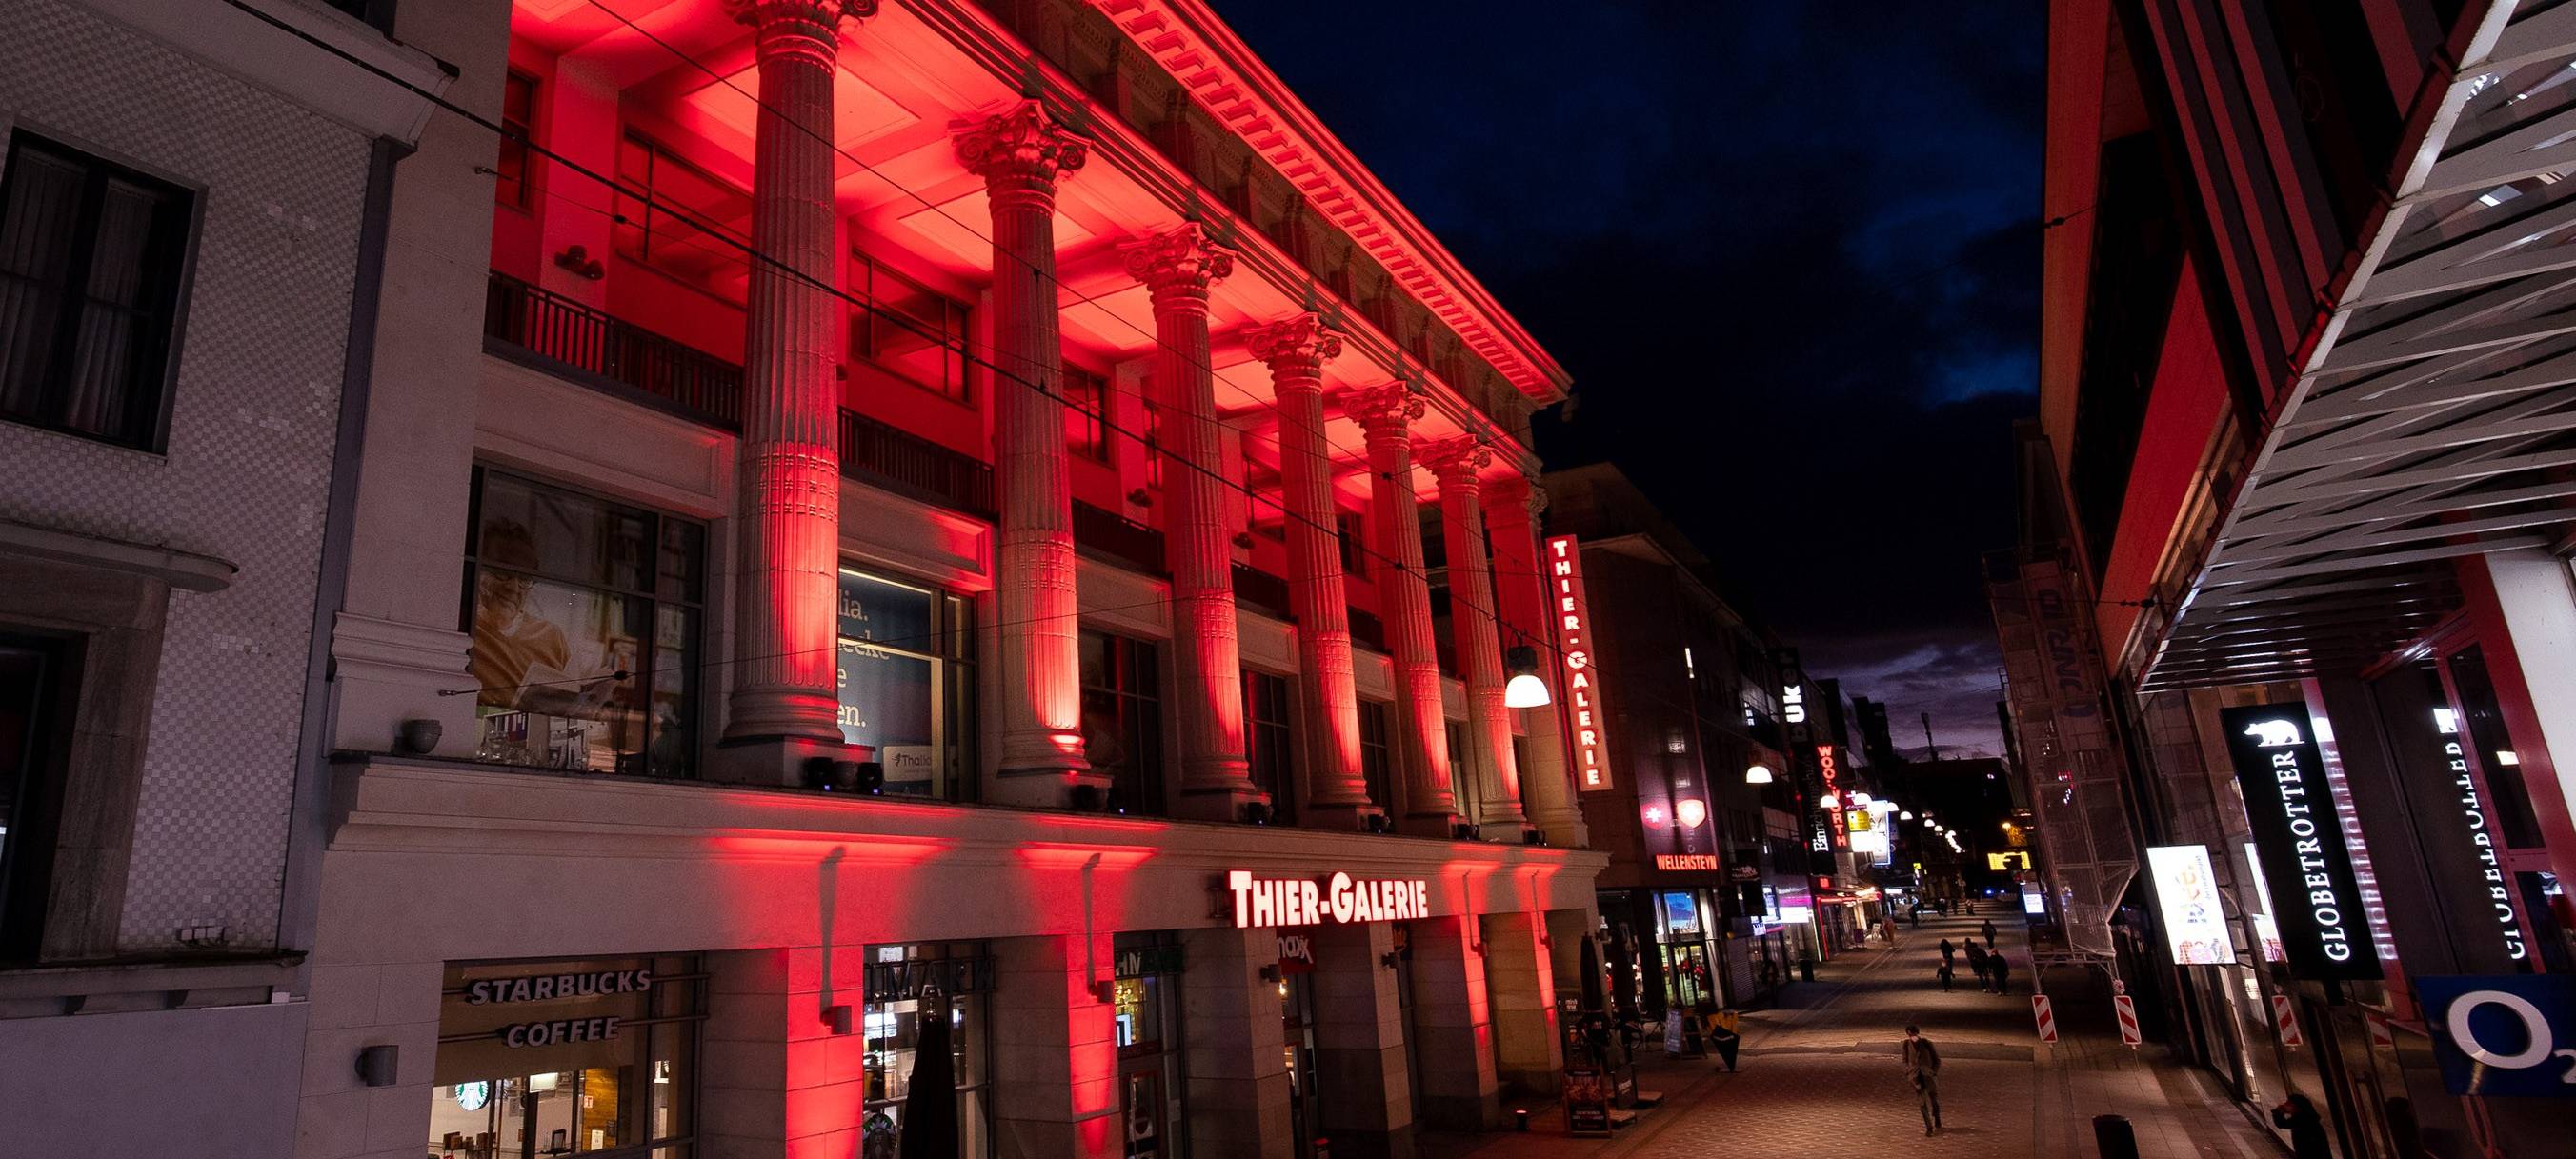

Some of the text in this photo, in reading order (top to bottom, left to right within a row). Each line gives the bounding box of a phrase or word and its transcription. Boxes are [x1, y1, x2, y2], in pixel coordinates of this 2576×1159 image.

[1553, 540, 1600, 785] THIER-GALERIE
[1817, 746, 1846, 847] WOOWORTH
[1657, 855, 1718, 870] WELLENSTEYN
[2272, 750, 2351, 961] GLOBETROTTER
[1230, 870, 1428, 929] THIER-GALERIE
[470, 970, 651, 1005] STARBUCKS
[507, 1017, 620, 1049] COFFEE
